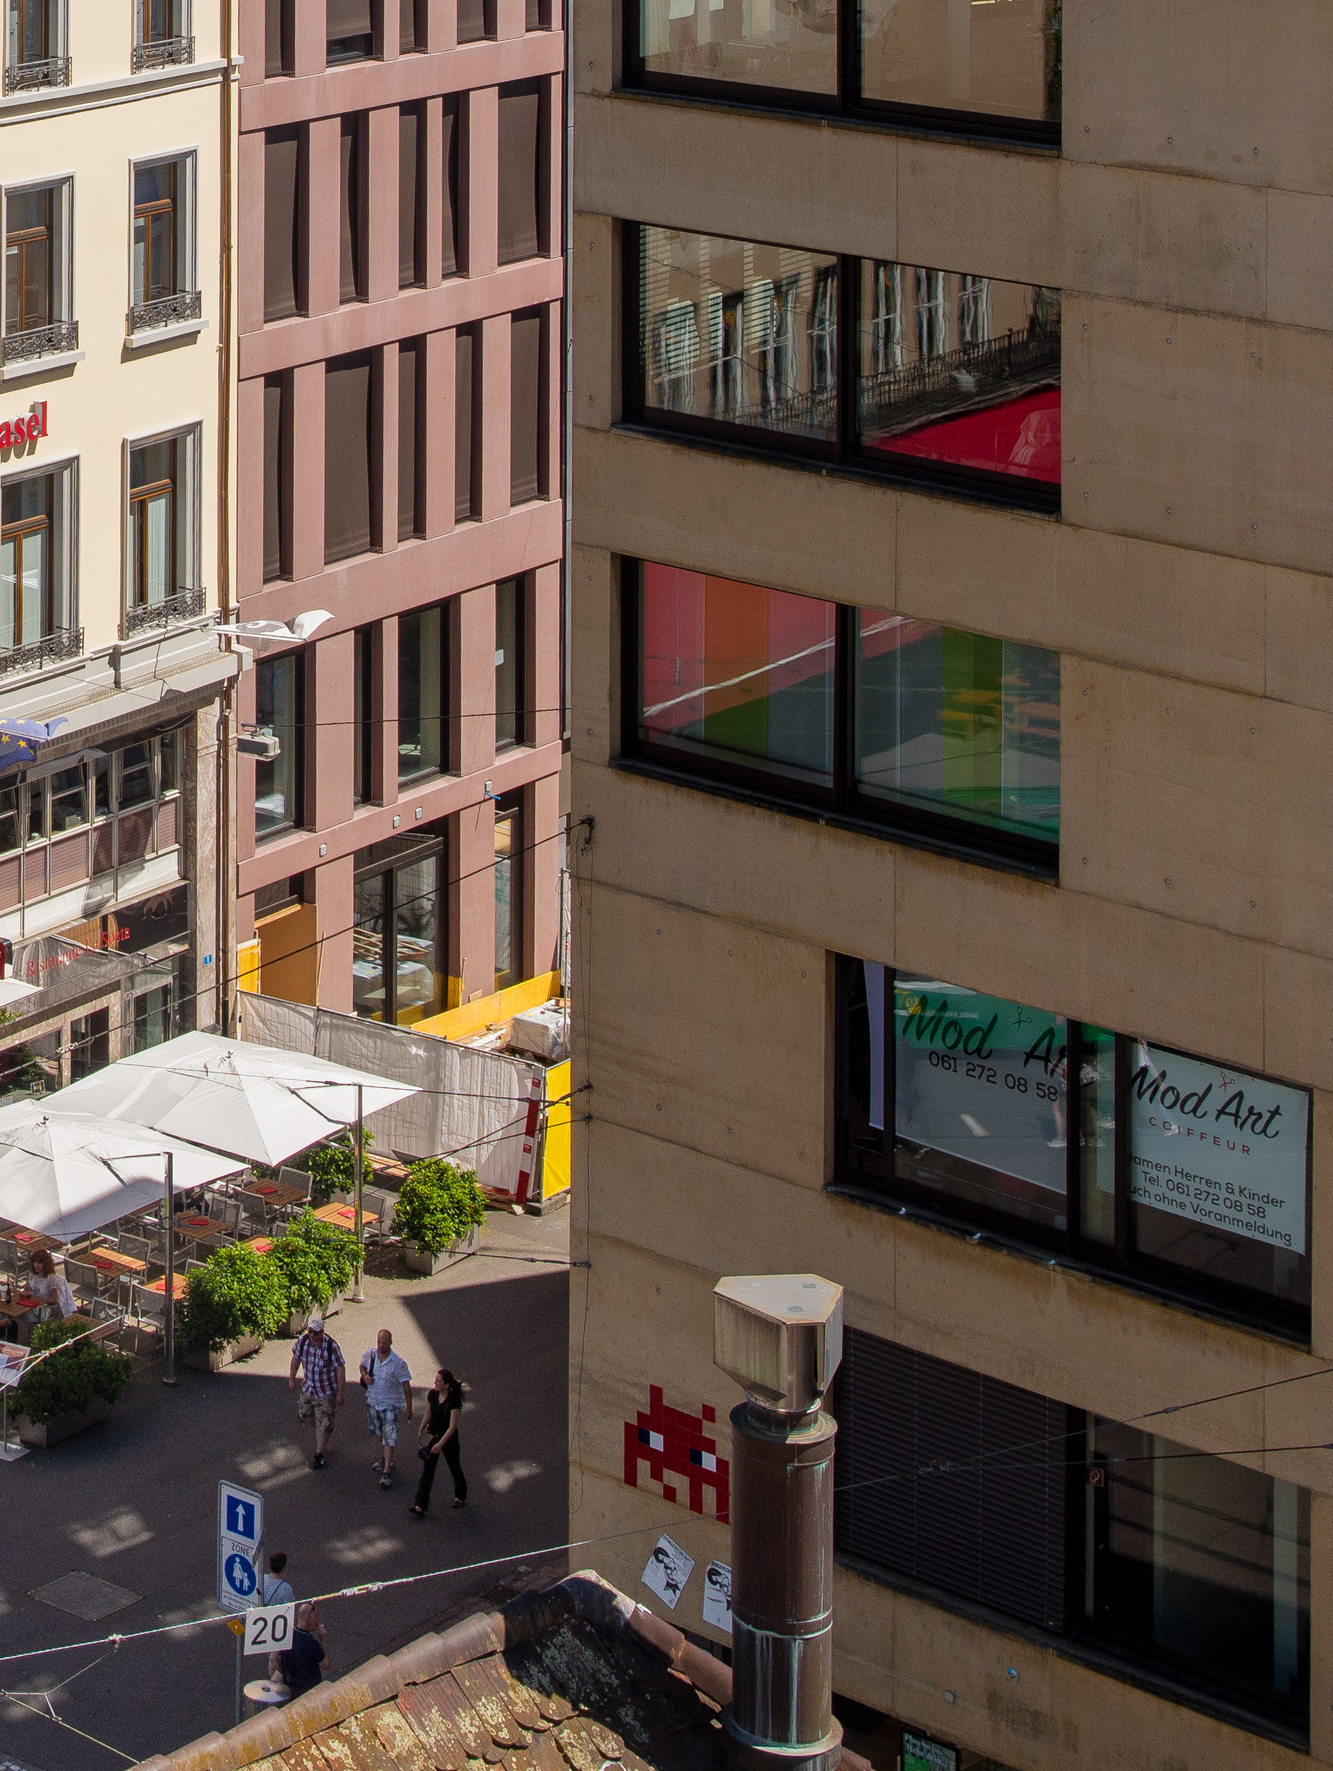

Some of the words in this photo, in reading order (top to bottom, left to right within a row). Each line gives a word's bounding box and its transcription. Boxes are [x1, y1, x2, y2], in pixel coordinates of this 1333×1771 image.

[101, 926, 131, 949] Sosta
[902, 993, 998, 1060] Mod
[1023, 1025, 1068, 1079] Ar
[928, 1050, 959, 1074] 061
[965, 1061, 998, 1085] 272
[1004, 1072, 1028, 1094] 08
[1035, 1081, 1059, 1103] 58
[1131, 1064, 1213, 1120] Mod
[1214, 1089, 1284, 1139] Art
[1148, 1116, 1251, 1156] COIFFEUR
[1131, 1153, 1171, 1176] amen
[1174, 1165, 1222, 1191] Herren
[1225, 1182, 1235, 1195] &
[1238, 1184, 1286, 1209] Kinder
[1141, 1170, 1163, 1189] Tel.
[1165, 1178, 1191, 1198] 061
[1193, 1186, 1221, 1207] 272
[1223, 1196, 1244, 1213] 08
[1246, 1202, 1267, 1219] 58
[1131, 1184, 1152, 1200] uch
[1153, 1190, 1187, 1211] ohne
[1190, 1199, 1293, 1248] Voranmeldung
[231, 1541, 251, 1557] ZONE
[251, 1614, 288, 1646] 20
